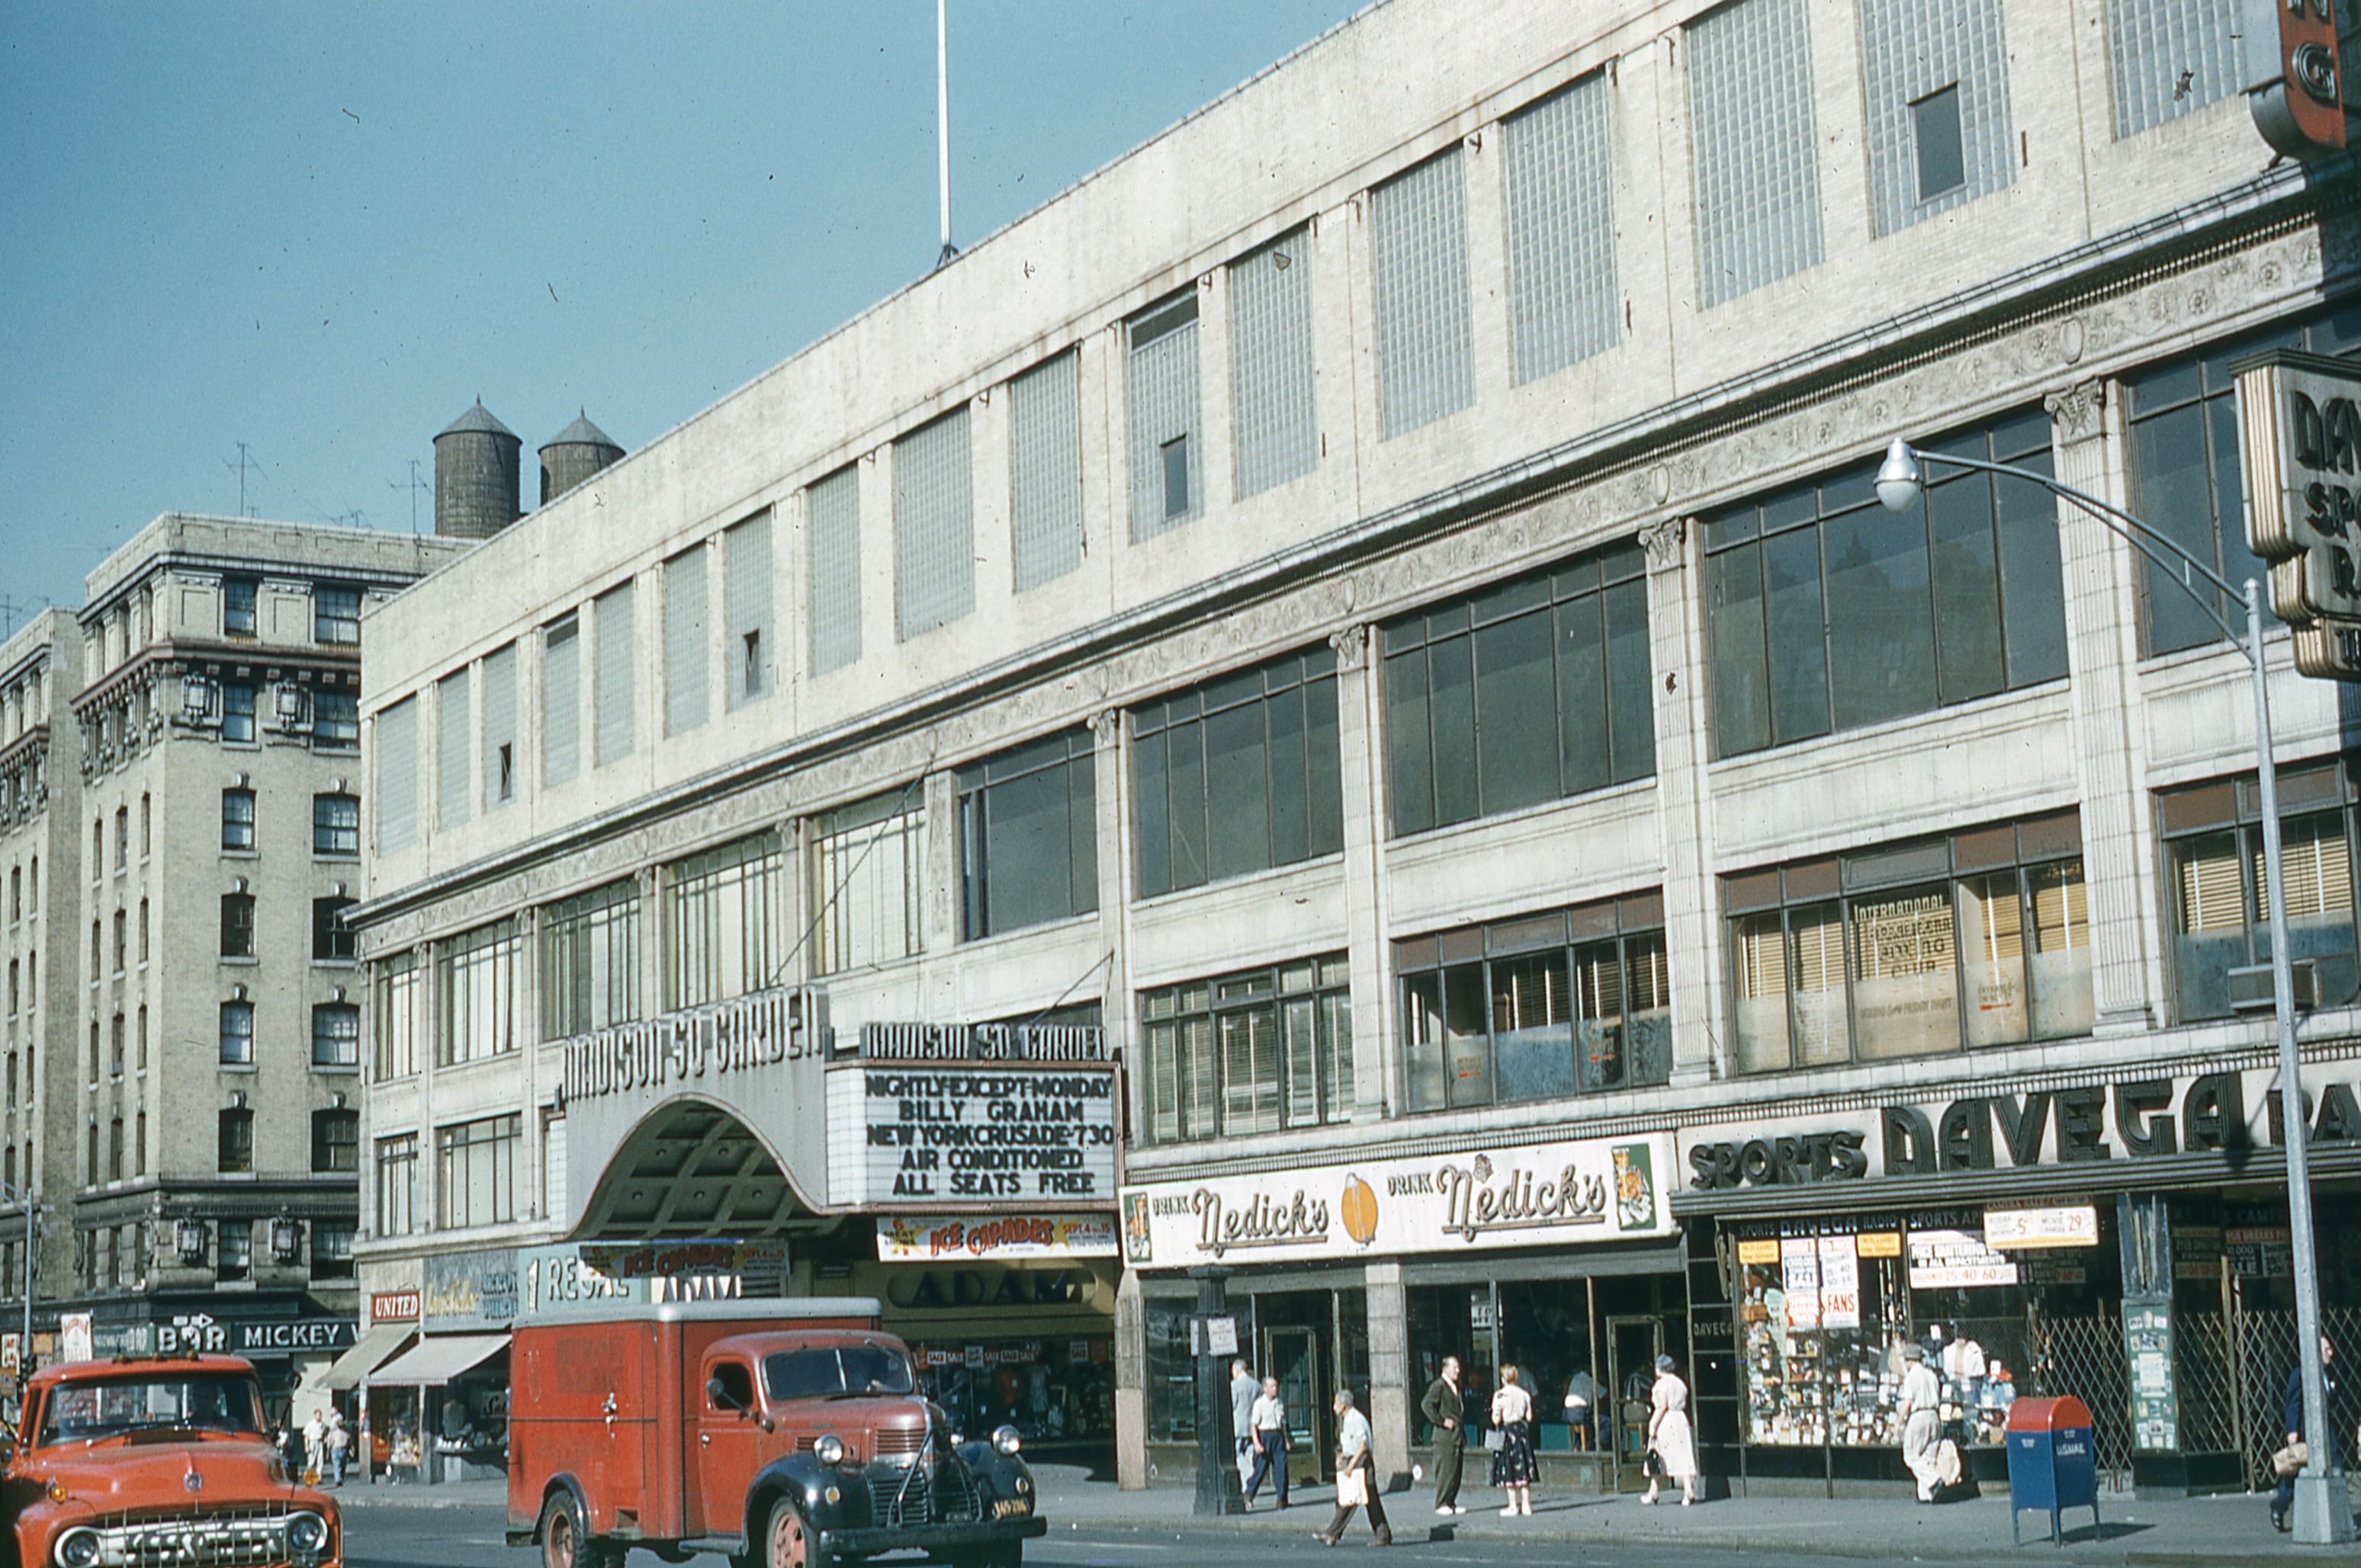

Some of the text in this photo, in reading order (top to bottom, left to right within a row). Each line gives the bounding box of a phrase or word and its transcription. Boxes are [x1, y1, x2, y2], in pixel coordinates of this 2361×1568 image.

[2304, 481, 2361, 540] SP
[562, 1020, 665, 1103] MADISON
[712, 984, 823, 1074] GARDEN
[866, 1023, 969, 1059] MADISON
[1020, 1023, 1107, 1061] GARDEN
[898, 1100, 1084, 1123] BILLY GRAHAM
[867, 1124, 917, 1146] NEW
[917, 1124, 974, 1146] YORK
[1689, 1071, 2361, 1189] SPORTS DAVEGA RA
[901, 1149, 1083, 1171] AIR CONDITIONED
[893, 1173, 1095, 1196] ALL SEATS FREE
[1387, 1165, 1607, 1243] DRINK Nedick's
[1152, 1188, 1329, 1258] DRINK Nedick's
[1739, 1209, 1984, 1237] SPORTS DAVEGA RADIO SPORTS AP
[930, 1217, 1055, 1257] ICE CAPADES
[624, 1244, 735, 1277] ICE CAPADES
[910, 1269, 1085, 1307] ADAM
[1962, 1269, 1977, 1280] 40
[374, 1295, 418, 1318] UNITED
[1827, 1294, 1855, 1313] FANS
[158, 1325, 226, 1352] BAR
[244, 1323, 339, 1348] MICKEY
[1694, 1322, 1733, 1336] DAVEGA
